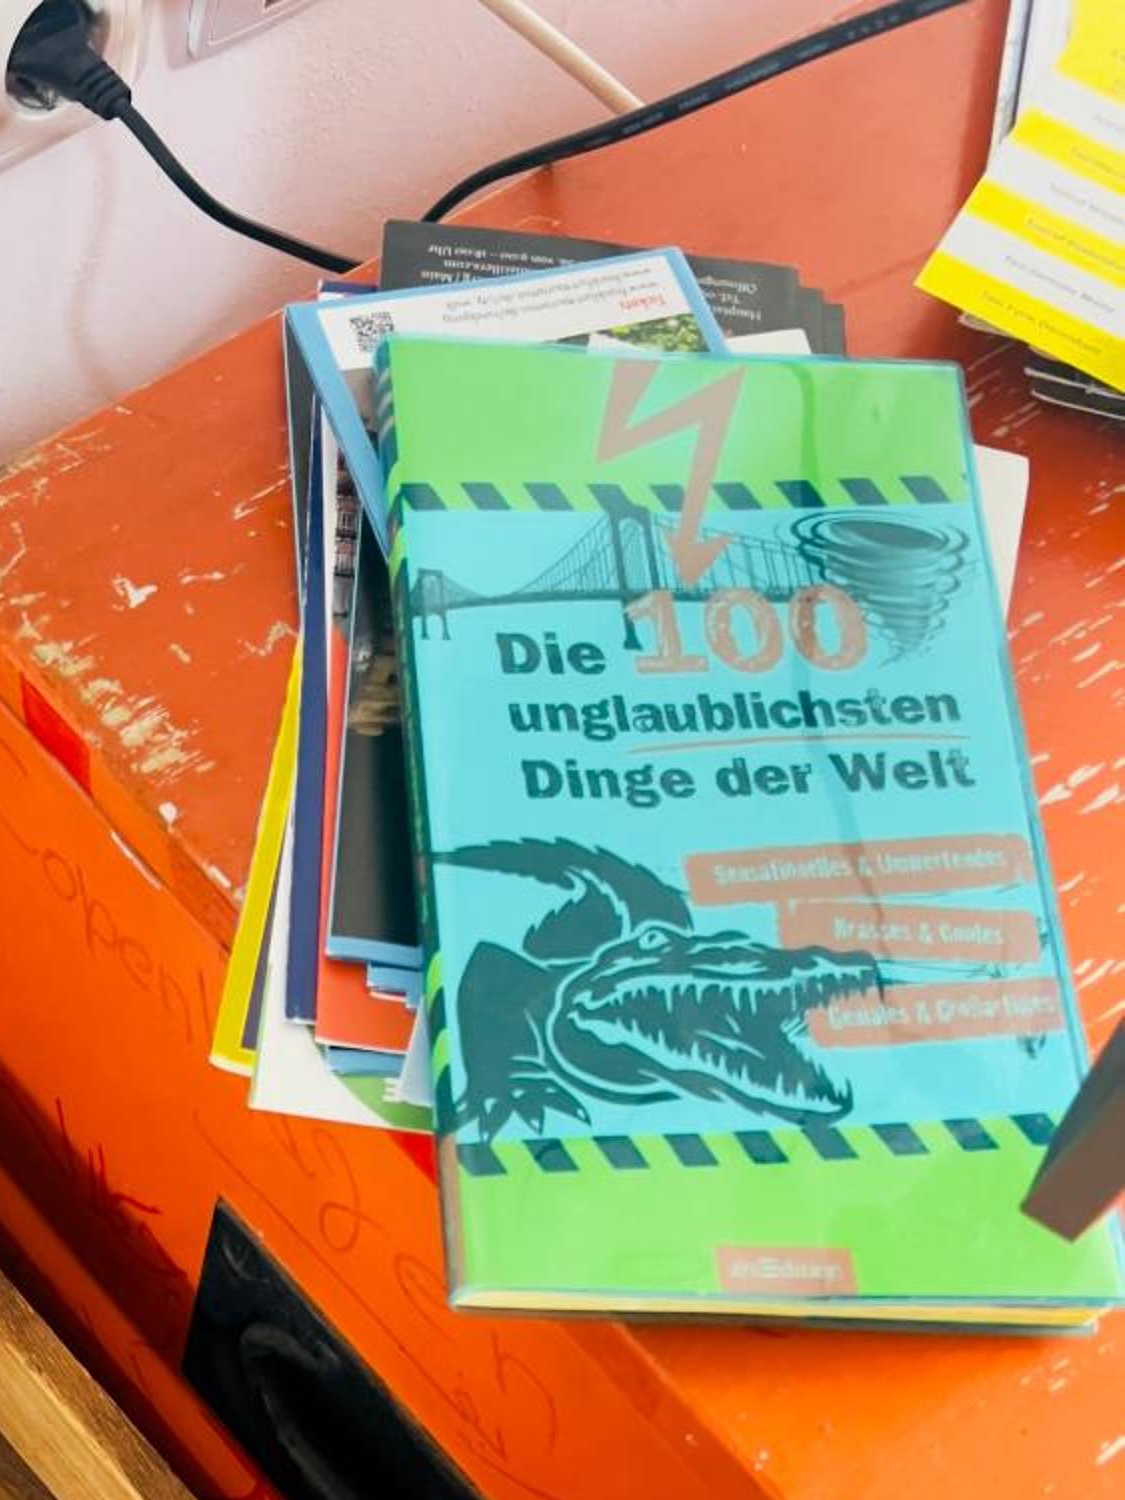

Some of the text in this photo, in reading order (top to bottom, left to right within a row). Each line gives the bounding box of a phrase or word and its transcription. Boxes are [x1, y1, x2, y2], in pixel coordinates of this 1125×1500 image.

[494, 583, 870, 675] Die 100
[506, 689, 961, 742] unglaublichsten
[520, 748, 976, 808] Dinge der Welt
